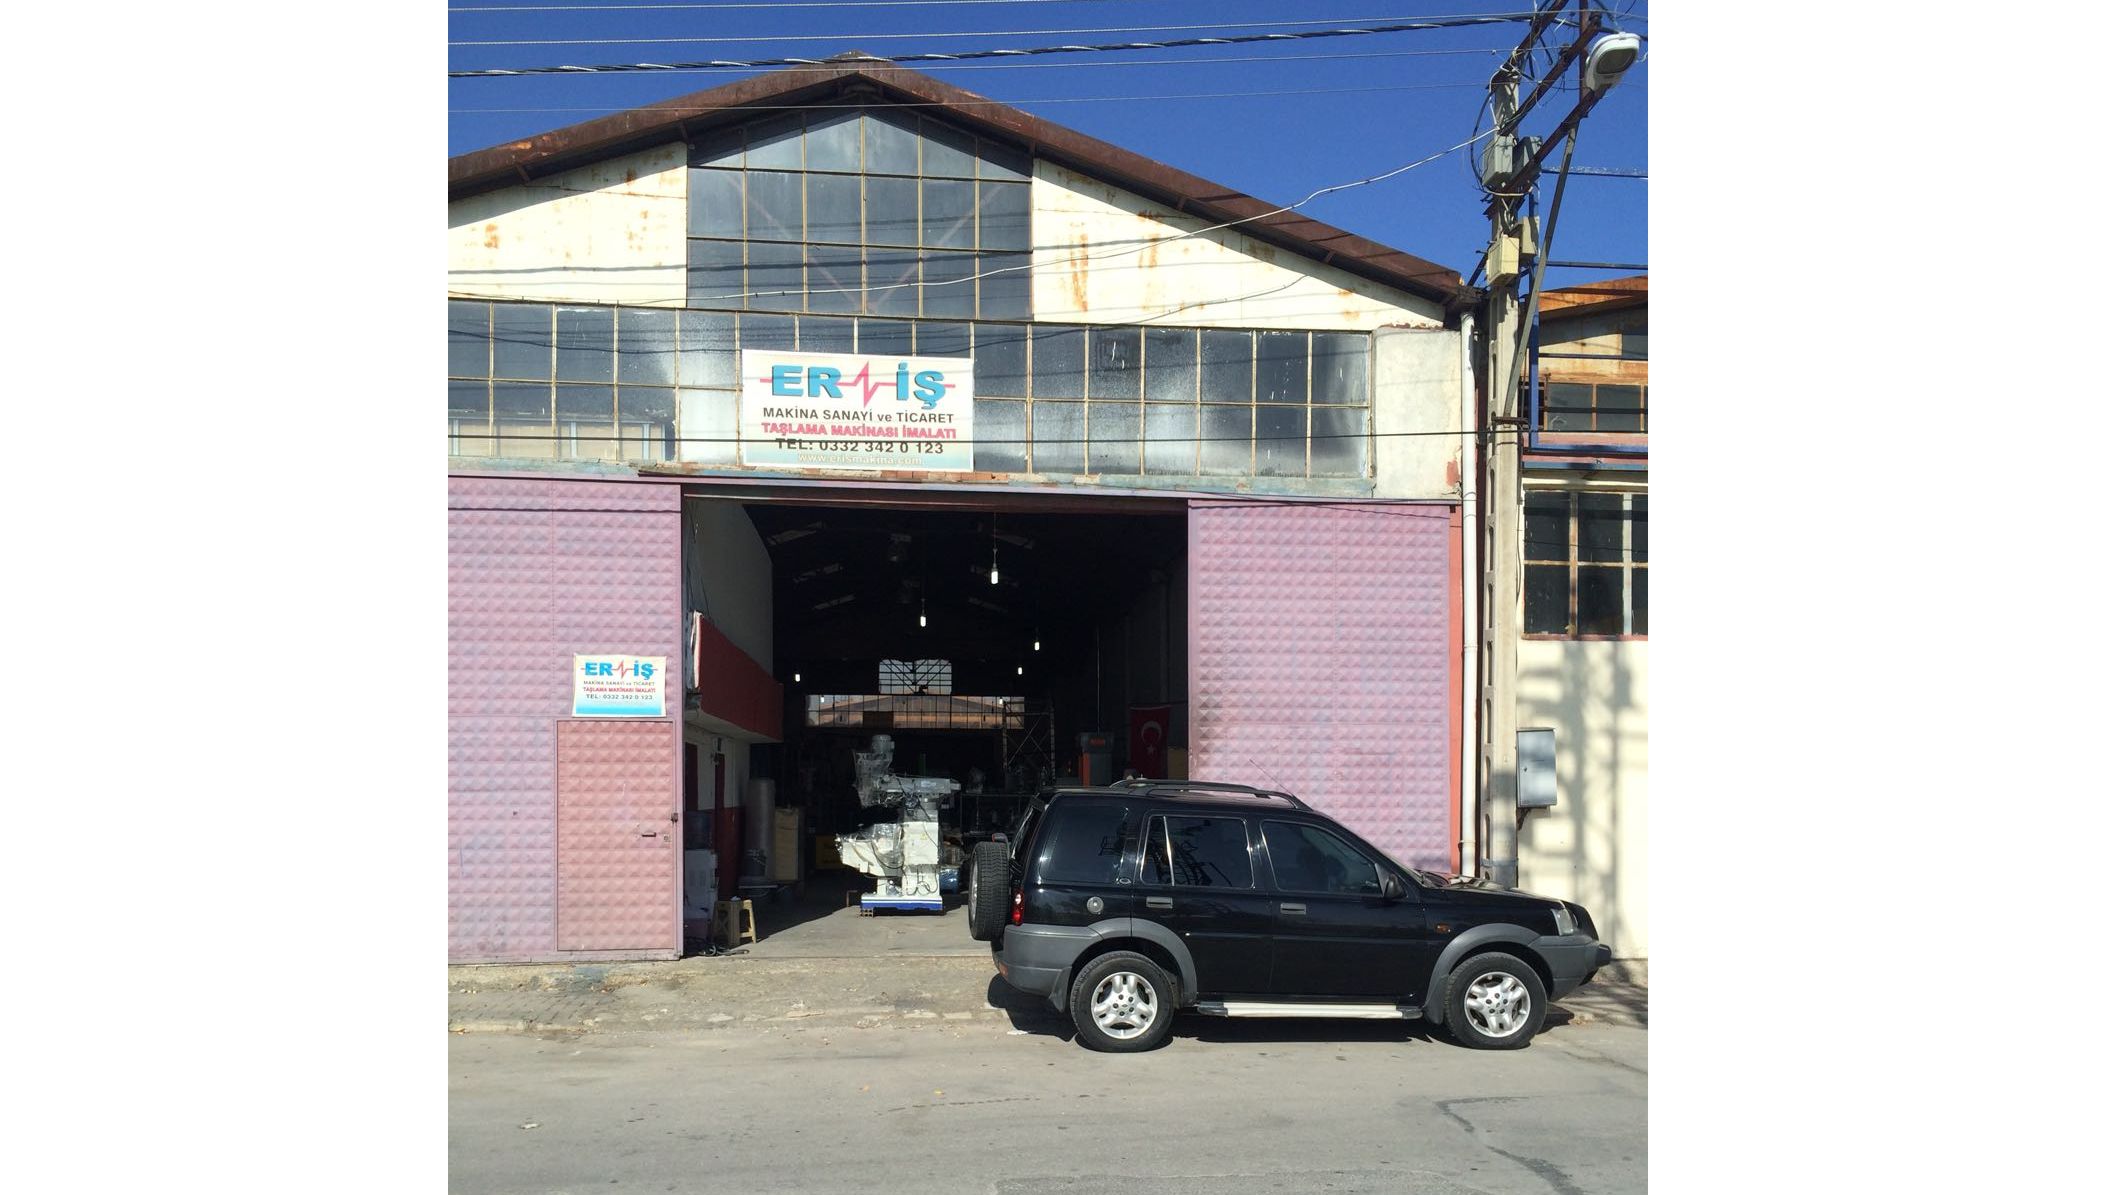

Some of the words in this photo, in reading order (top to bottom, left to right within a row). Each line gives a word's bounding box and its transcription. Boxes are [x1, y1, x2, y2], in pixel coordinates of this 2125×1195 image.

[763, 406, 818, 419] MAKİNA
[823, 409, 873, 421] SANAYİ
[877, 414, 892, 422] ve
[896, 411, 954, 424] TİCARET
[761, 422, 827, 436] TAŞLAMA
[831, 424, 898, 438] MAKİNASI
[902, 425, 957, 439] İMALATI
[776, 438, 813, 450] TEL:
[819, 440, 859, 452] 0332
[865, 440, 894, 453] 342
[899, 441, 909, 453] 0
[916, 441, 944, 454] 123
